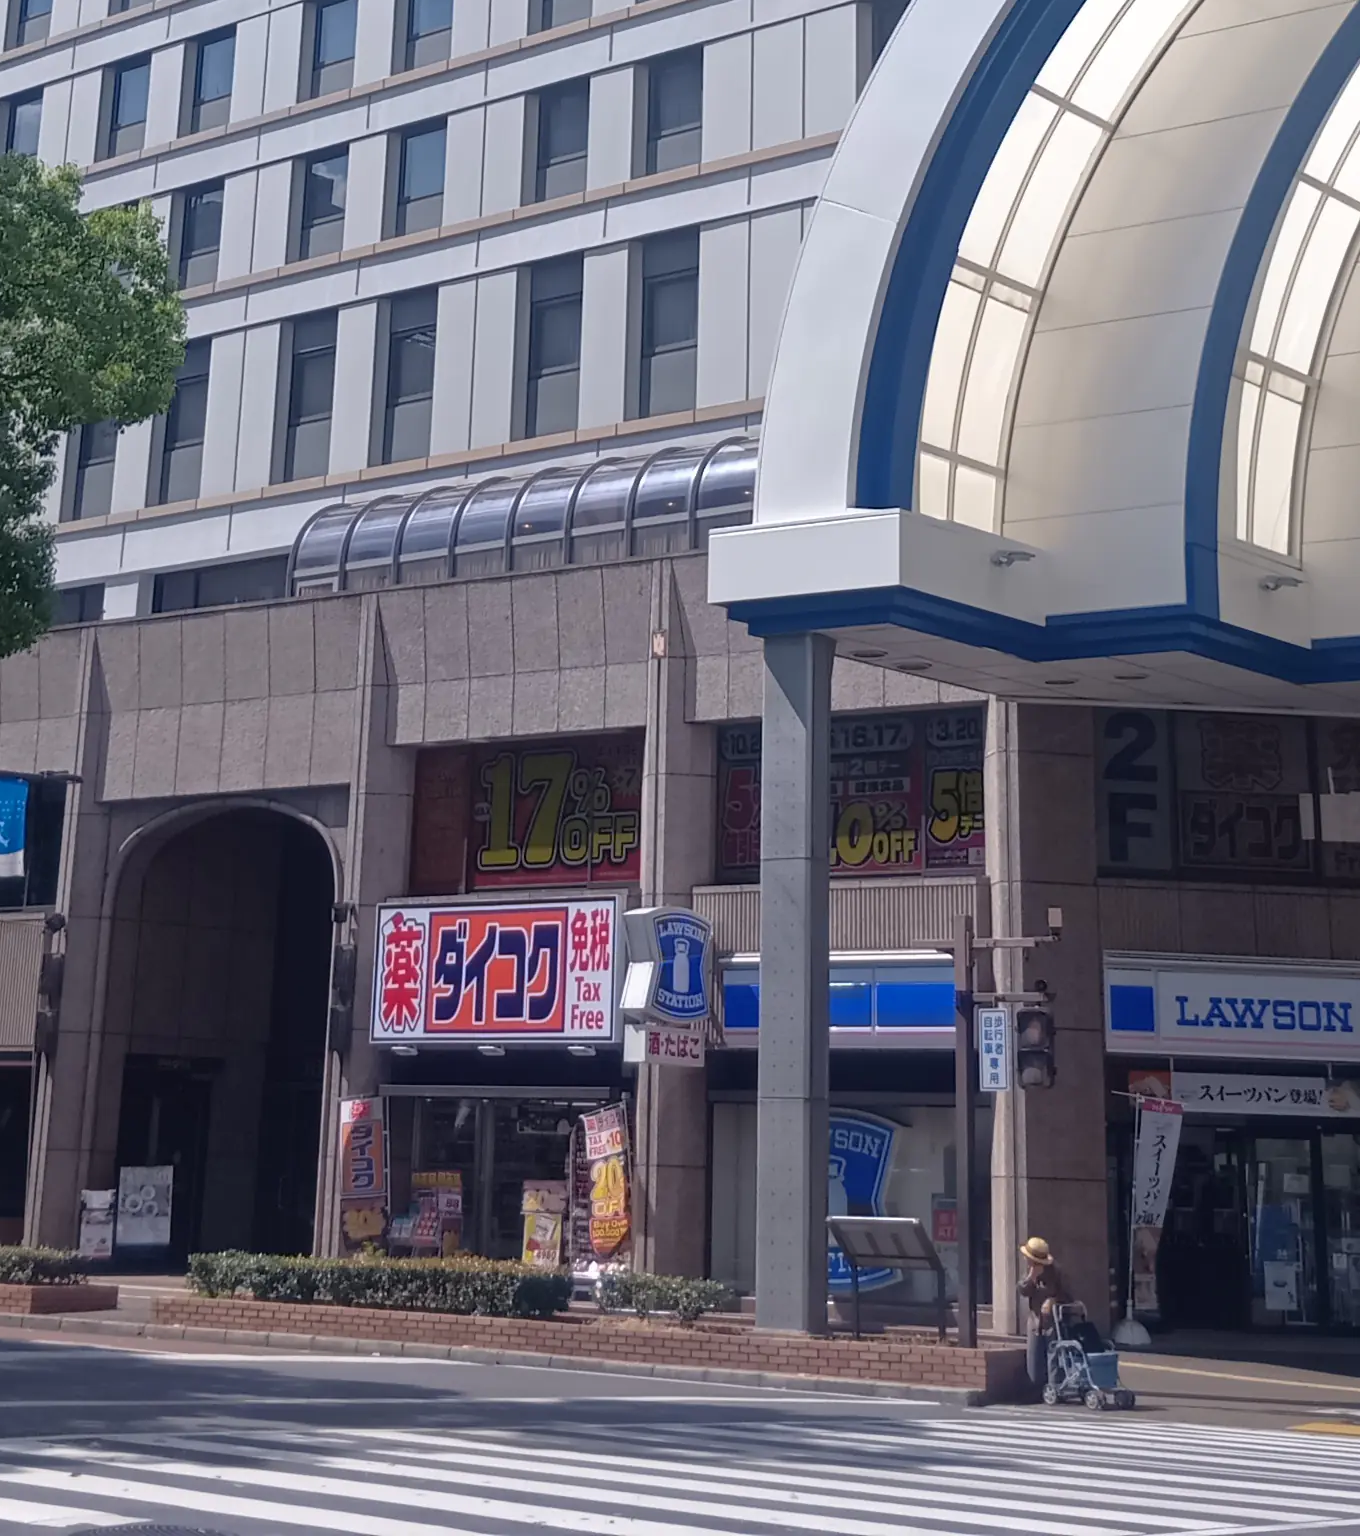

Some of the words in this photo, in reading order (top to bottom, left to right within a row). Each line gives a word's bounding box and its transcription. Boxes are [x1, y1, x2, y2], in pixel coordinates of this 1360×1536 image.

[560, 810, 640, 867] OFF
[873, 829, 920, 866] OFF
[1189, 802, 1302, 862] ダイコク
[569, 907, 611, 974] 免税
[658, 921, 709, 944] LAWSON
[381, 911, 426, 1034] 薬
[432, 919, 562, 1025] ダイコク
[574, 975, 602, 1003] Tax
[570, 1003, 605, 1031] Free
[657, 987, 704, 1009] STATION
[1174, 994, 1354, 1033] LAWSON
